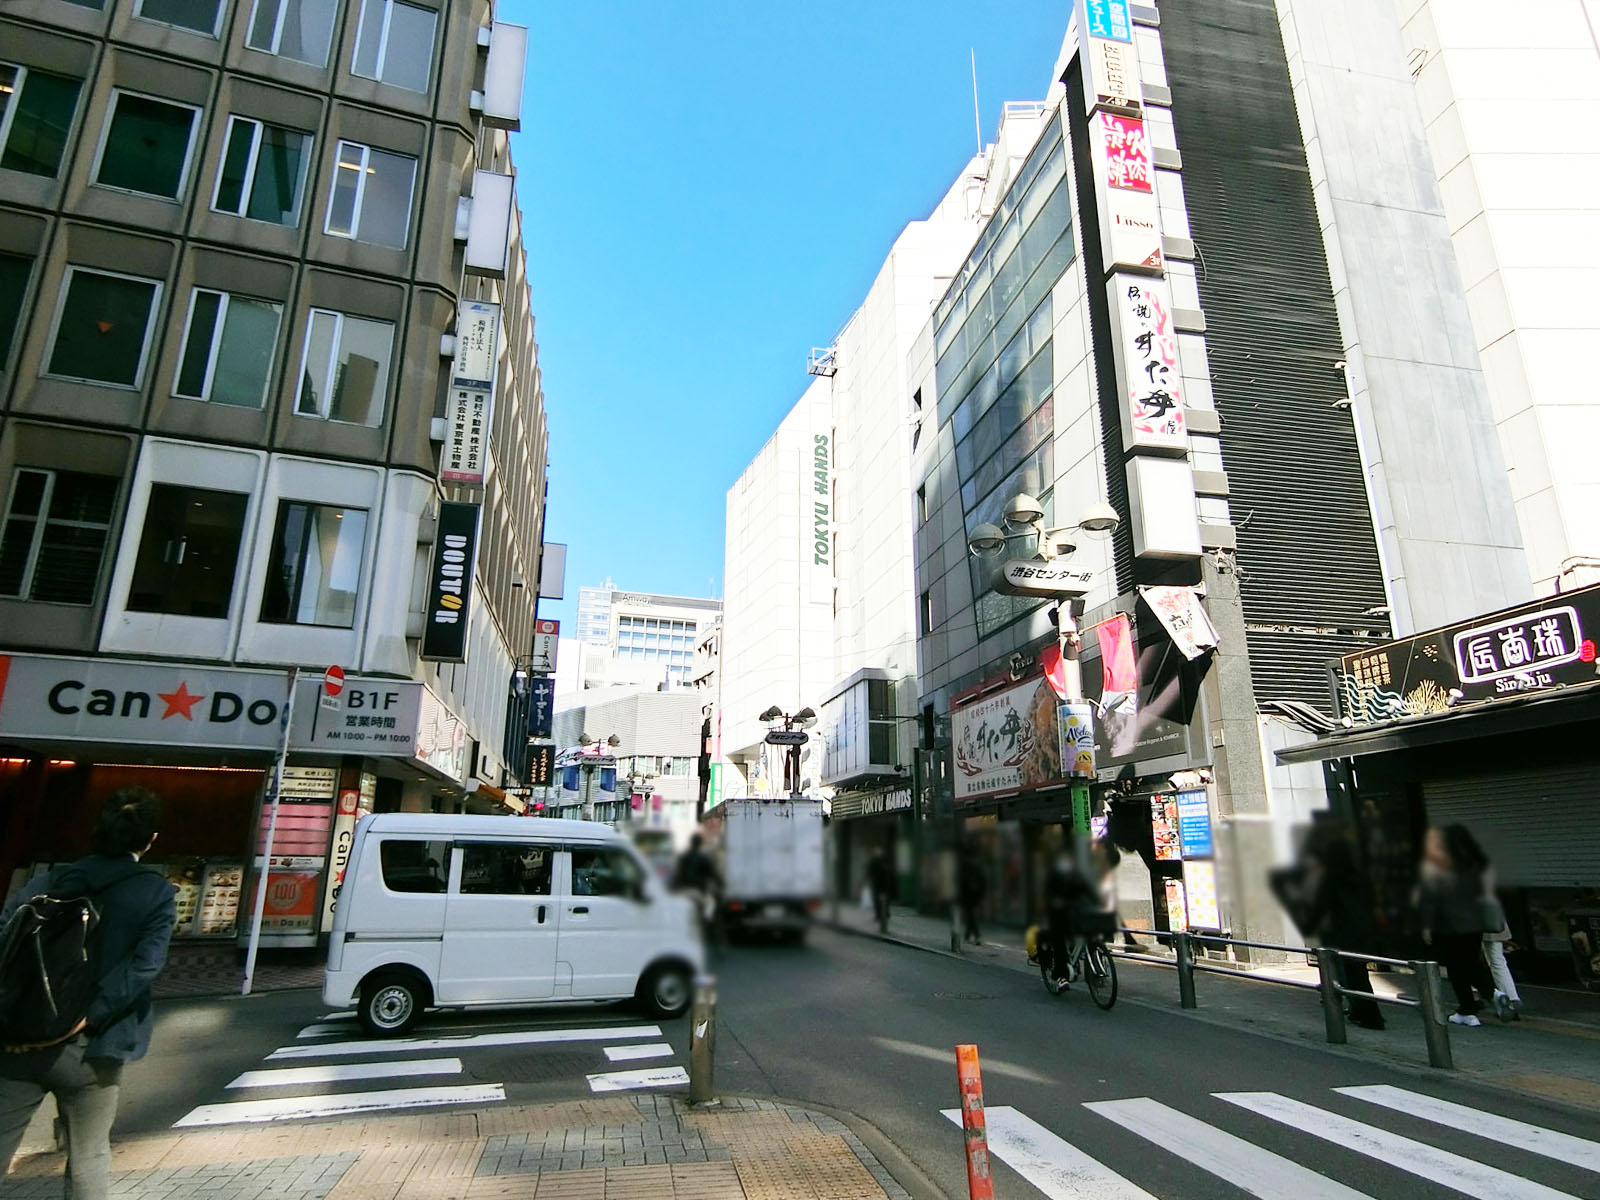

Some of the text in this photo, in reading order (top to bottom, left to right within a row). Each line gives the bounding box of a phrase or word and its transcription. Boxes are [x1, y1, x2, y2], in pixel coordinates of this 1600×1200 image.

[1115, 214, 1154, 230] Lusso
[1150, 255, 1161, 266] 3F
[814, 434, 829, 495] HANDS
[814, 501, 829, 566] TOKYU
[435, 534, 467, 624] DOUTOR
[1010, 565, 1093, 584] 渋谷センター街
[622, 593, 651, 604] Amway
[47, 680, 278, 725] Can Do
[346, 690, 400, 711] B1F
[345, 715, 396, 729] 営業時間
[326, 730, 340, 740] AM
[342, 732, 364, 741] 10:00
[373, 733, 387, 742] PM
[388, 734, 411, 743] 10:00
[861, 788, 912, 815] TOKYU HANDS
[336, 831, 351, 866] Can
